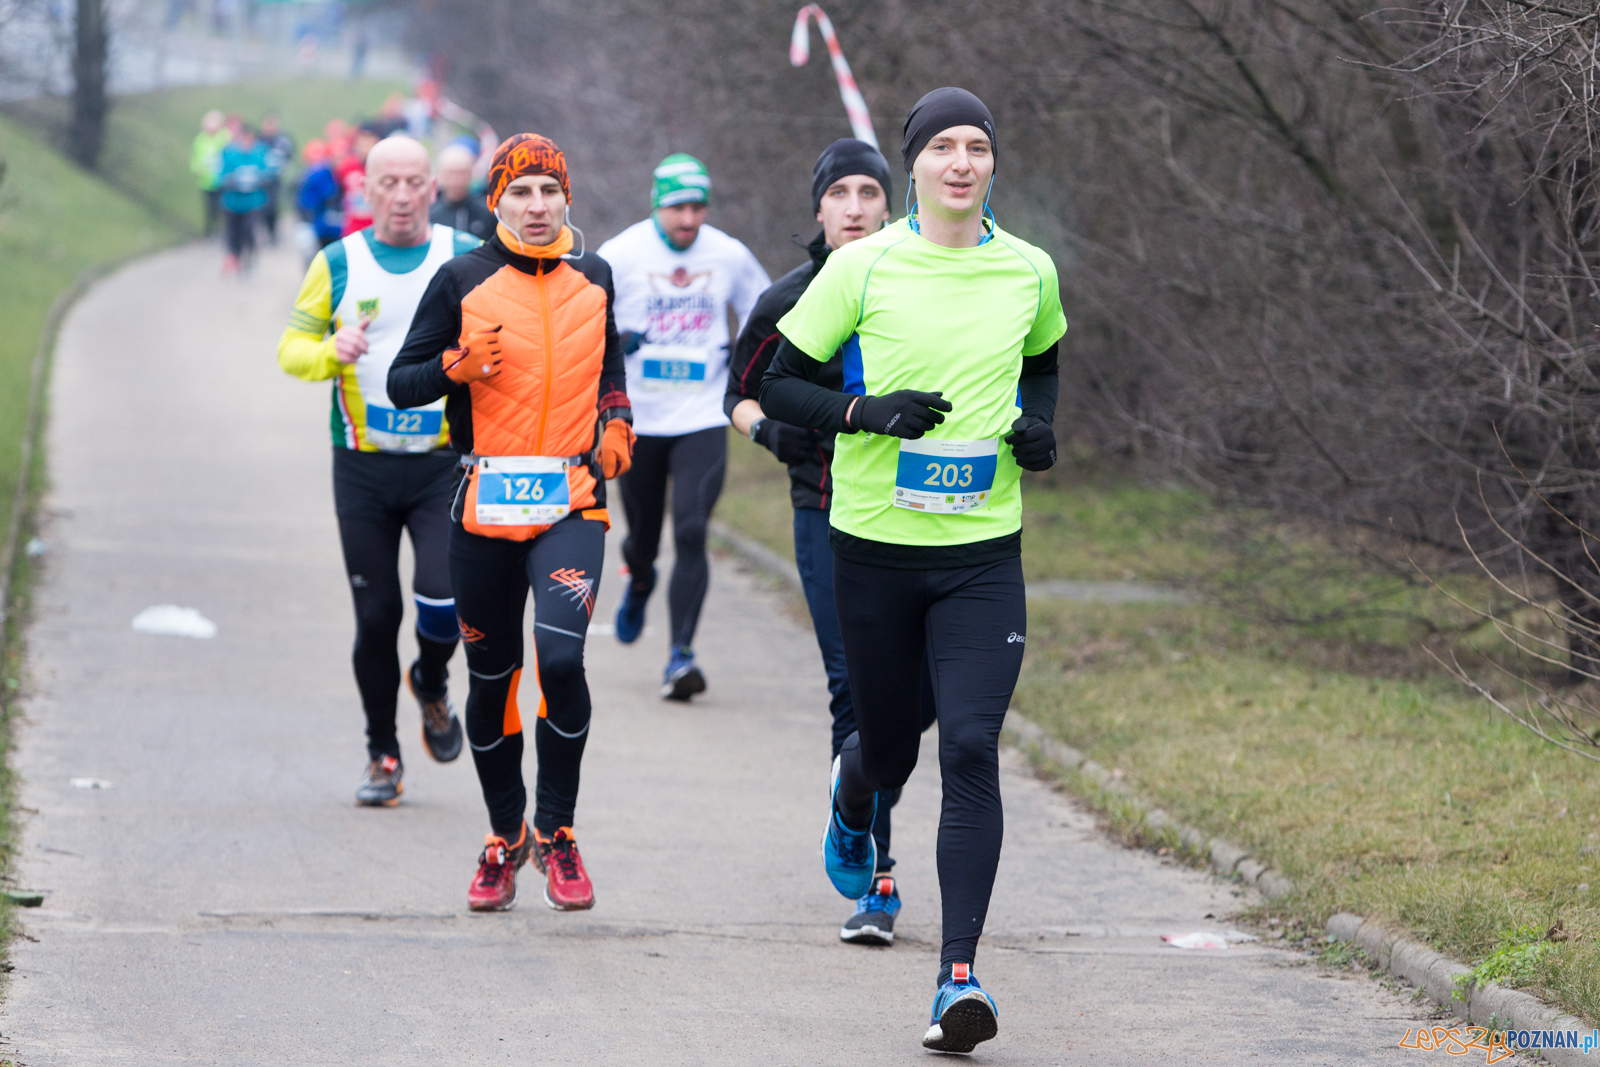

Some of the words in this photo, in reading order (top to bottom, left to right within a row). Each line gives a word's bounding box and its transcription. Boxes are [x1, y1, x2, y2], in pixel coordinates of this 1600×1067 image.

[386, 412, 423, 432] 122
[924, 463, 973, 487] 203
[502, 477, 545, 501] 126
